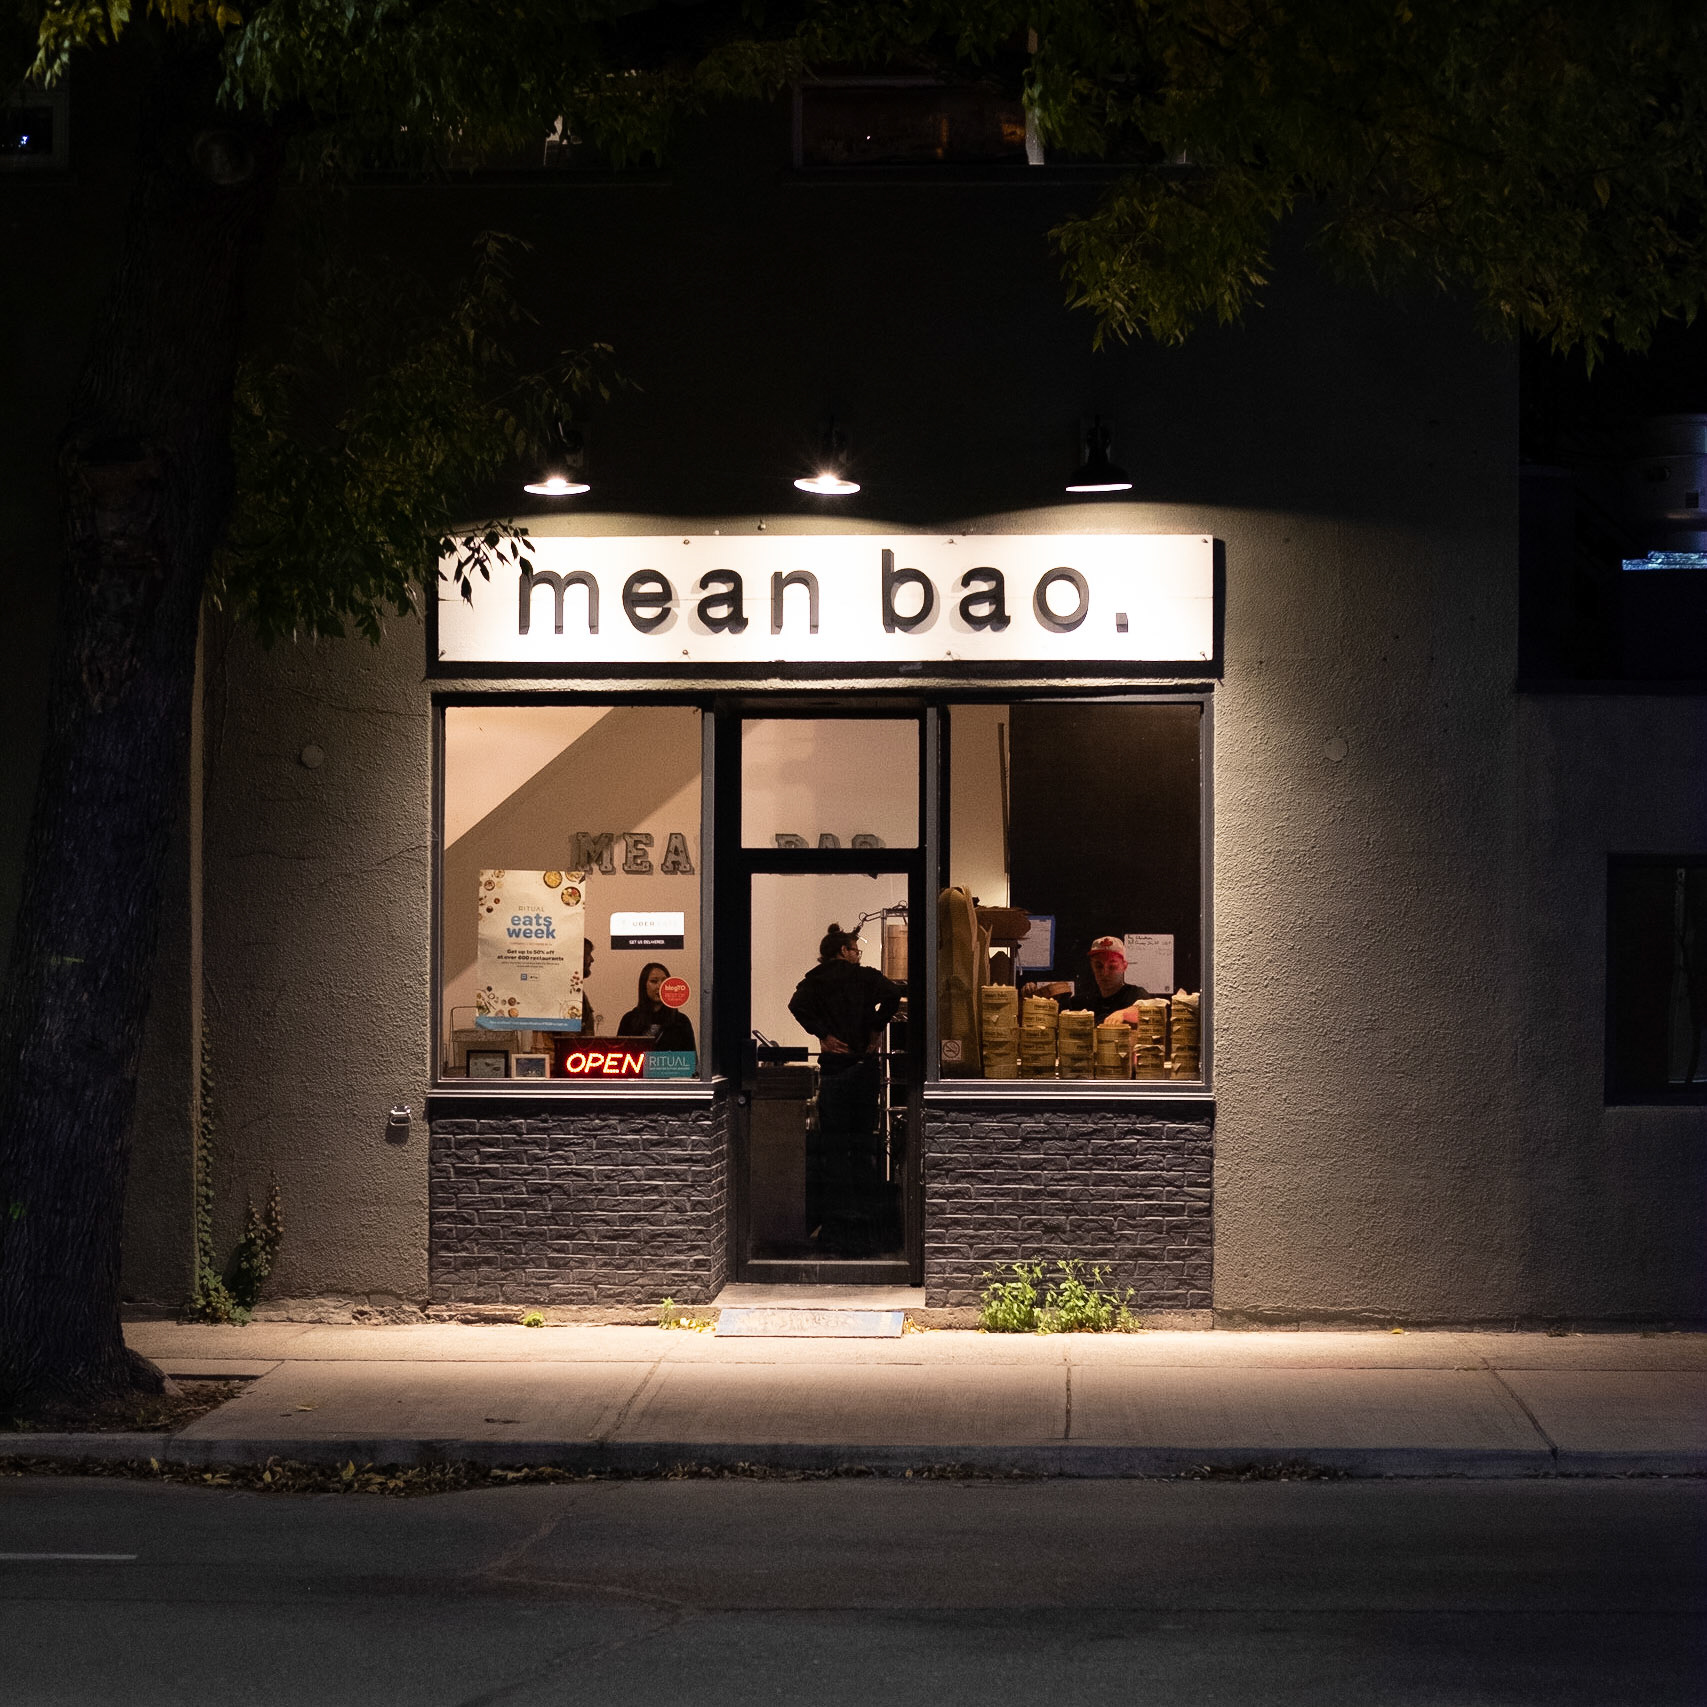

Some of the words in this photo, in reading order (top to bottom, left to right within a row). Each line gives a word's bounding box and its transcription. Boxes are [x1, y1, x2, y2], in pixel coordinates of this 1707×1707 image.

[519, 568, 820, 635] mean
[881, 548, 1129, 634] bao.
[511, 913, 552, 927] eats
[506, 924, 556, 939] week
[566, 1052, 645, 1074] OPEN
[649, 1056, 691, 1067] RITUAL
